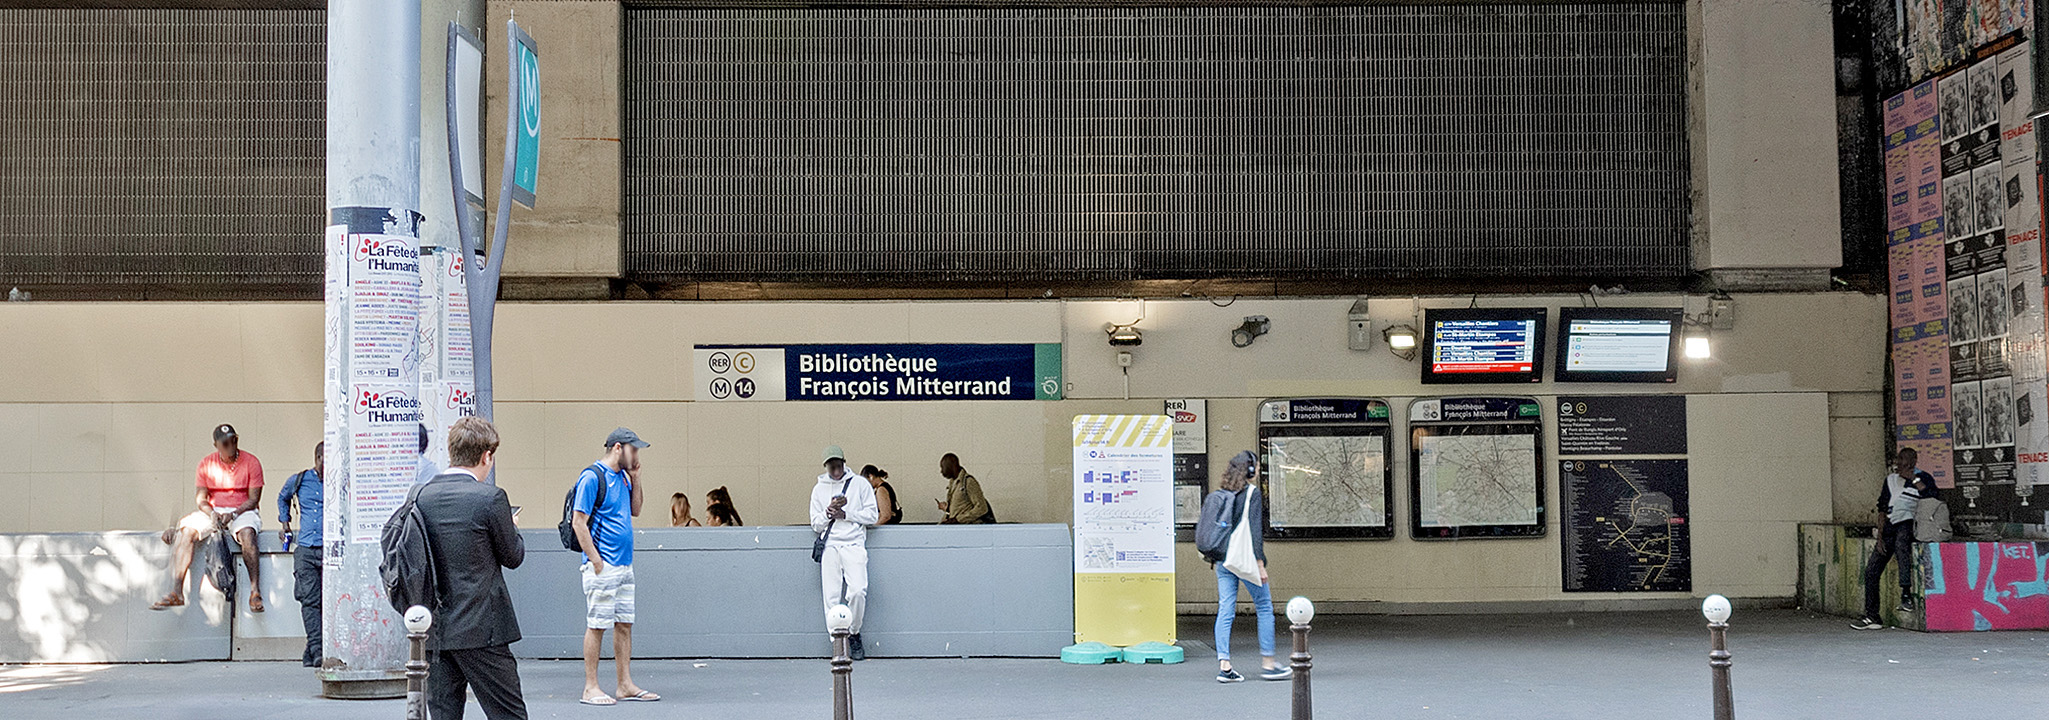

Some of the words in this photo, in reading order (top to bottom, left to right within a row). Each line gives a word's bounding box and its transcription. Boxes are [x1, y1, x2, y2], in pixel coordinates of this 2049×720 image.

[525, 61, 537, 117] M
[2002, 121, 2033, 141] TENACE
[2008, 229, 2038, 245] TENACE
[368, 244, 385, 257] La
[386, 245, 410, 258] Fête
[712, 358, 728, 367] RER
[799, 353, 938, 377] Bibliothèque
[715, 382, 727, 395] M
[736, 381, 753, 395] 14
[800, 376, 889, 399] François
[896, 376, 1011, 395] Mitterrand
[368, 397, 385, 409] La
[386, 396, 410, 409] Fête
[459, 394, 472, 405] La
[1176, 414, 1195, 422] SNCF
[1444, 411, 1472, 419] François
[1473, 410, 1508, 418] Mitterrand
[2018, 452, 2048, 463] TENACE
